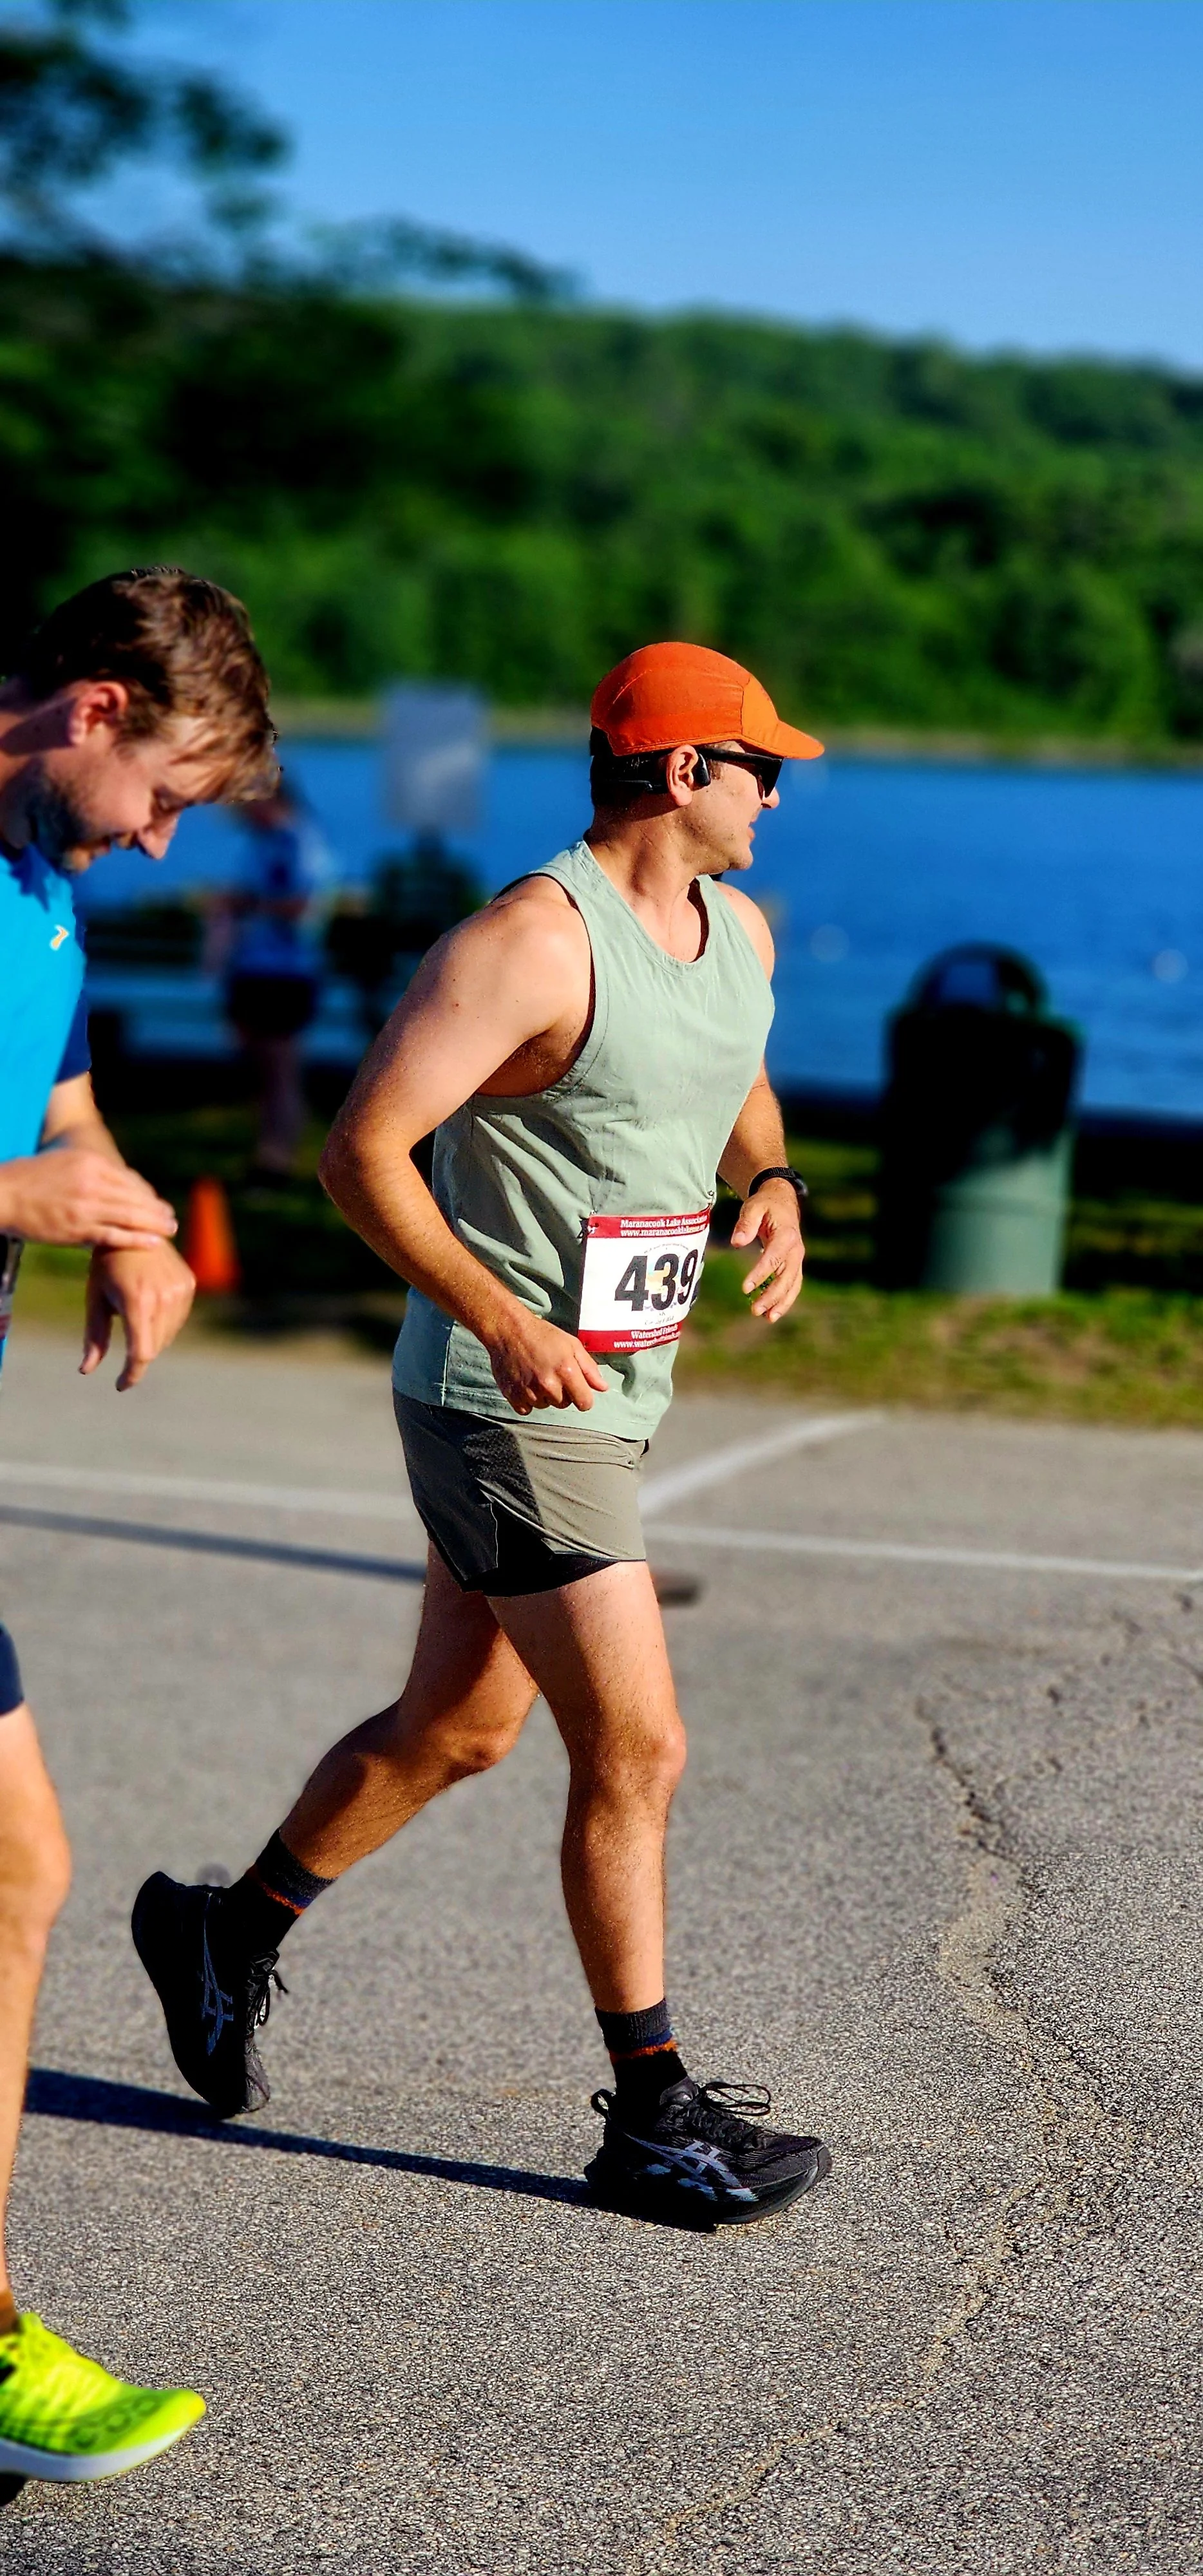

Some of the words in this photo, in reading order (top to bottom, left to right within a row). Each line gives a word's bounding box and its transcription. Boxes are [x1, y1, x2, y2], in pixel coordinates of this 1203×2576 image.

[620, 1218, 666, 1229] Maranacook
[666, 1217, 681, 1227] Lake
[614, 1249, 705, 1312] 439
[630, 1328, 663, 1340] Watershed
